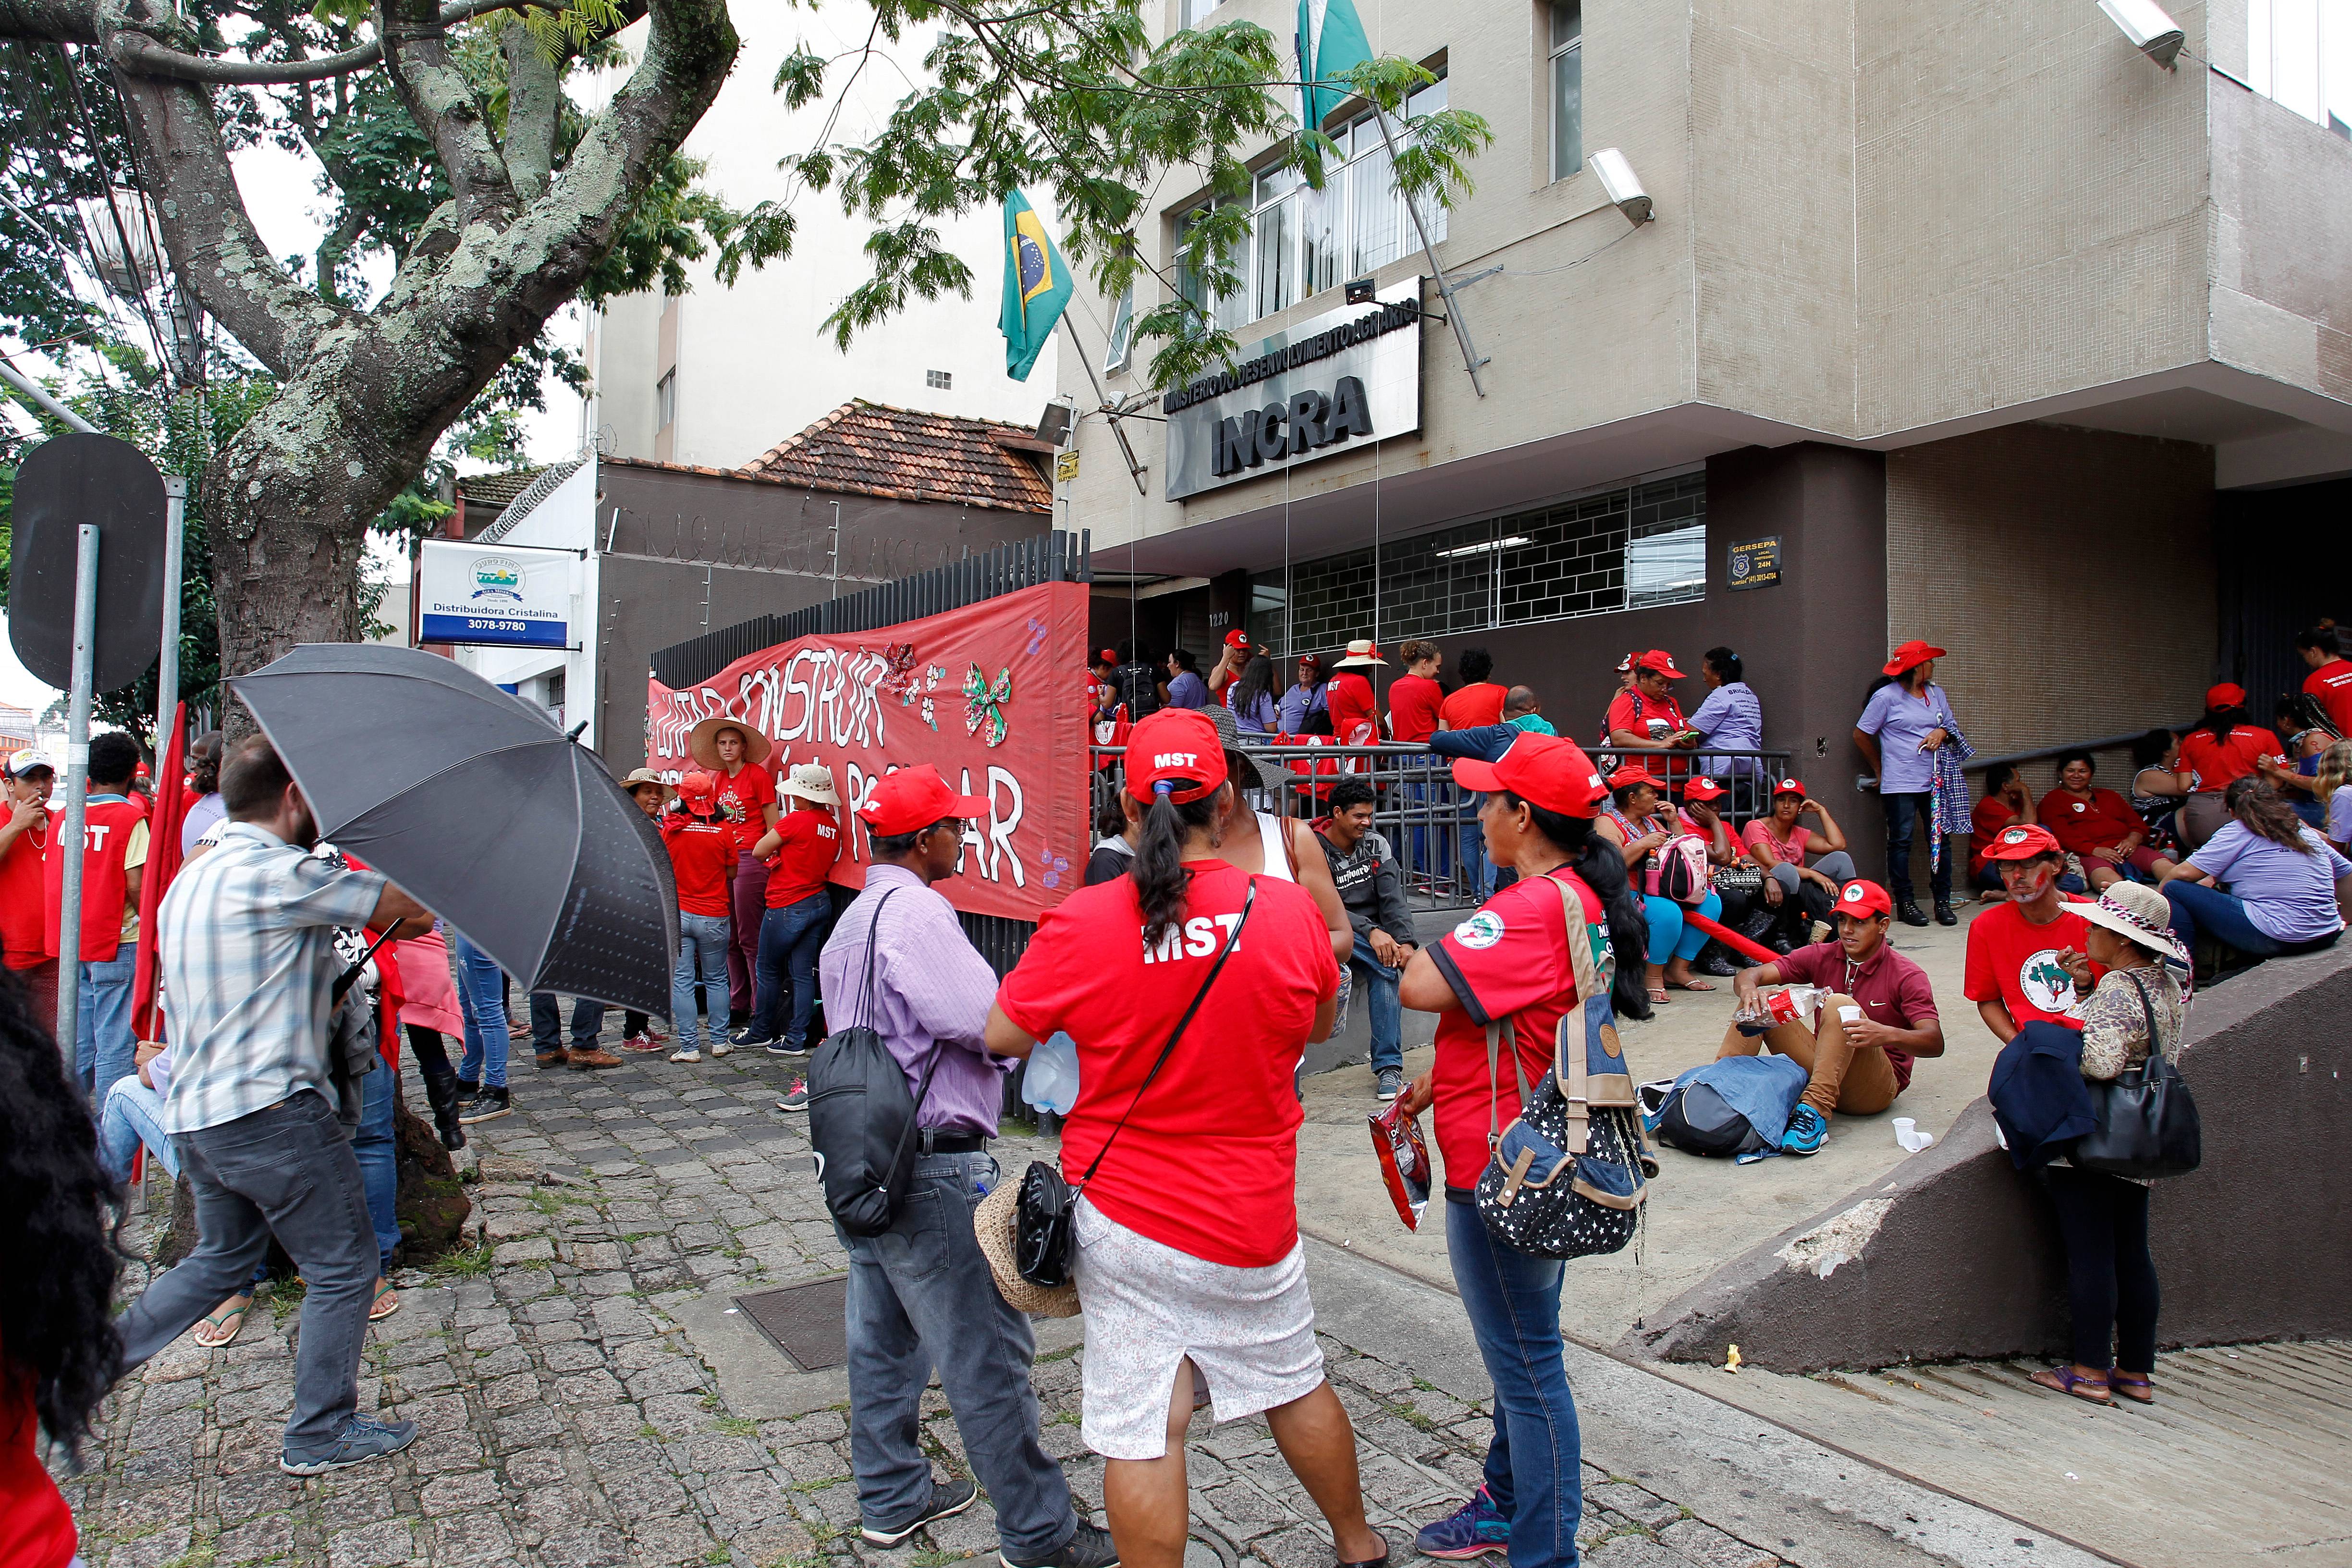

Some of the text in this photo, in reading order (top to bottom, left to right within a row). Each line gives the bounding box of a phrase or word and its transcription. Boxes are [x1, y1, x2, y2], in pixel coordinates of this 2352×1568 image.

[1238, 324, 1351, 385] DESENVOLVIMENTO
[1212, 376, 1373, 477] INCRA
[1733, 540, 1776, 553] GERSEPA
[434, 603, 558, 618] Distribuidora Cristalina
[468, 619, 526, 631] 3078-9780
[1210, 611, 1228, 627] 1220
[1154, 752, 1197, 769] MST
[2273, 754, 2287, 765] MS
[863, 800, 881, 812] ST
[817, 823, 836, 840] MST
[1141, 913, 1242, 964] MST
[2027, 951, 2057, 964] TRABALHADO
[2021, 974, 2034, 1001] MOVIMENTO
